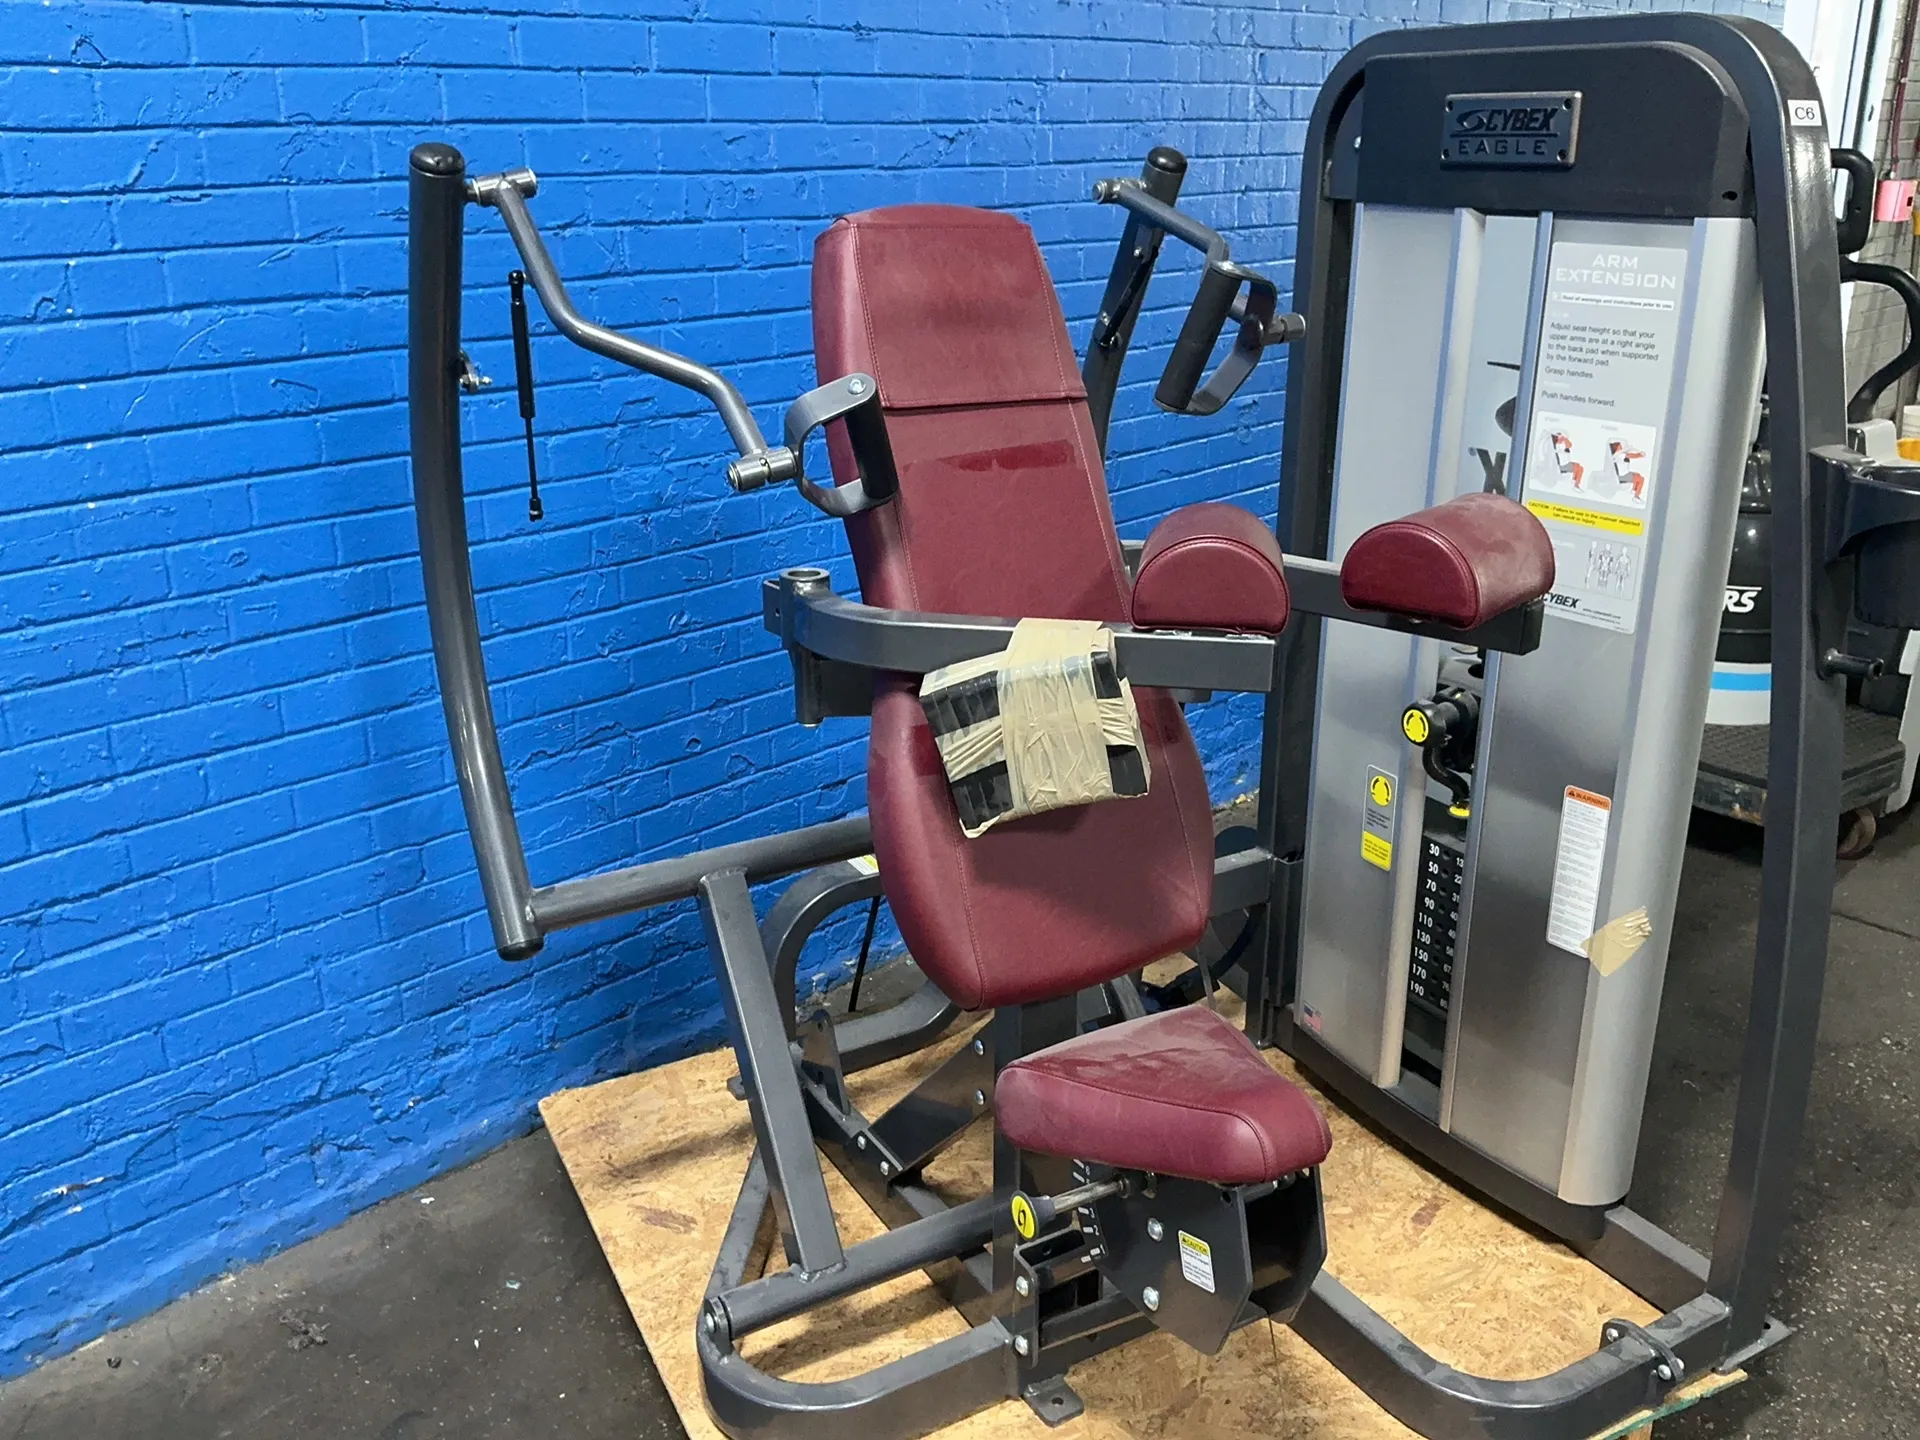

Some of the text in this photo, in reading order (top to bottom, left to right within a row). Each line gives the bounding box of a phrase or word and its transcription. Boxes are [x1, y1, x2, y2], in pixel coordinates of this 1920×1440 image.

[1484, 108, 1559, 132] CYBEX
[1794, 106, 1815, 120] C6
[1458, 139, 1547, 155] EAGLE
[1592, 254, 1638, 269] ARM
[1556, 268, 1677, 289] EXTENSION
[1550, 322, 1571, 331] Adjust
[1572, 325, 1588, 333] seat
[1588, 326, 1611, 335] height
[1622, 329, 1637, 337] that
[1638, 332, 1655, 340] your
[1549, 333, 1569, 341] upper
[1569, 335, 1587, 343] arms
[1616, 340, 1633, 349] right
[1635, 342, 1656, 351] angle
[1546, 353, 1554, 361] by
[1568, 355, 1594, 365] forward
[1556, 343, 1566, 351] the
[1567, 344, 1584, 353] back
[1585, 347, 1599, 355] pad
[1600, 349, 1620, 357] when
[1621, 351, 1660, 362] supported
[1544, 365, 1565, 376] Grasp
[1541, 390, 1558, 400] Push
[1560, 393, 1586, 403] handles
[1542, 592, 1580, 609] CYBEX
[1576, 792, 1609, 808] WARNING
[1429, 843, 1440, 857] 30
[1428, 861, 1439, 875] 50
[1426, 879, 1437, 892] 70
[1424, 897, 1435, 910] 90
[1419, 912, 1433, 928] 110
[1416, 929, 1431, 945] 130
[1414, 946, 1429, 962] 150
[1412, 963, 1427, 980] 170
[1410, 980, 1425, 996] 190
[1093, 1224, 1100, 1236] 2
